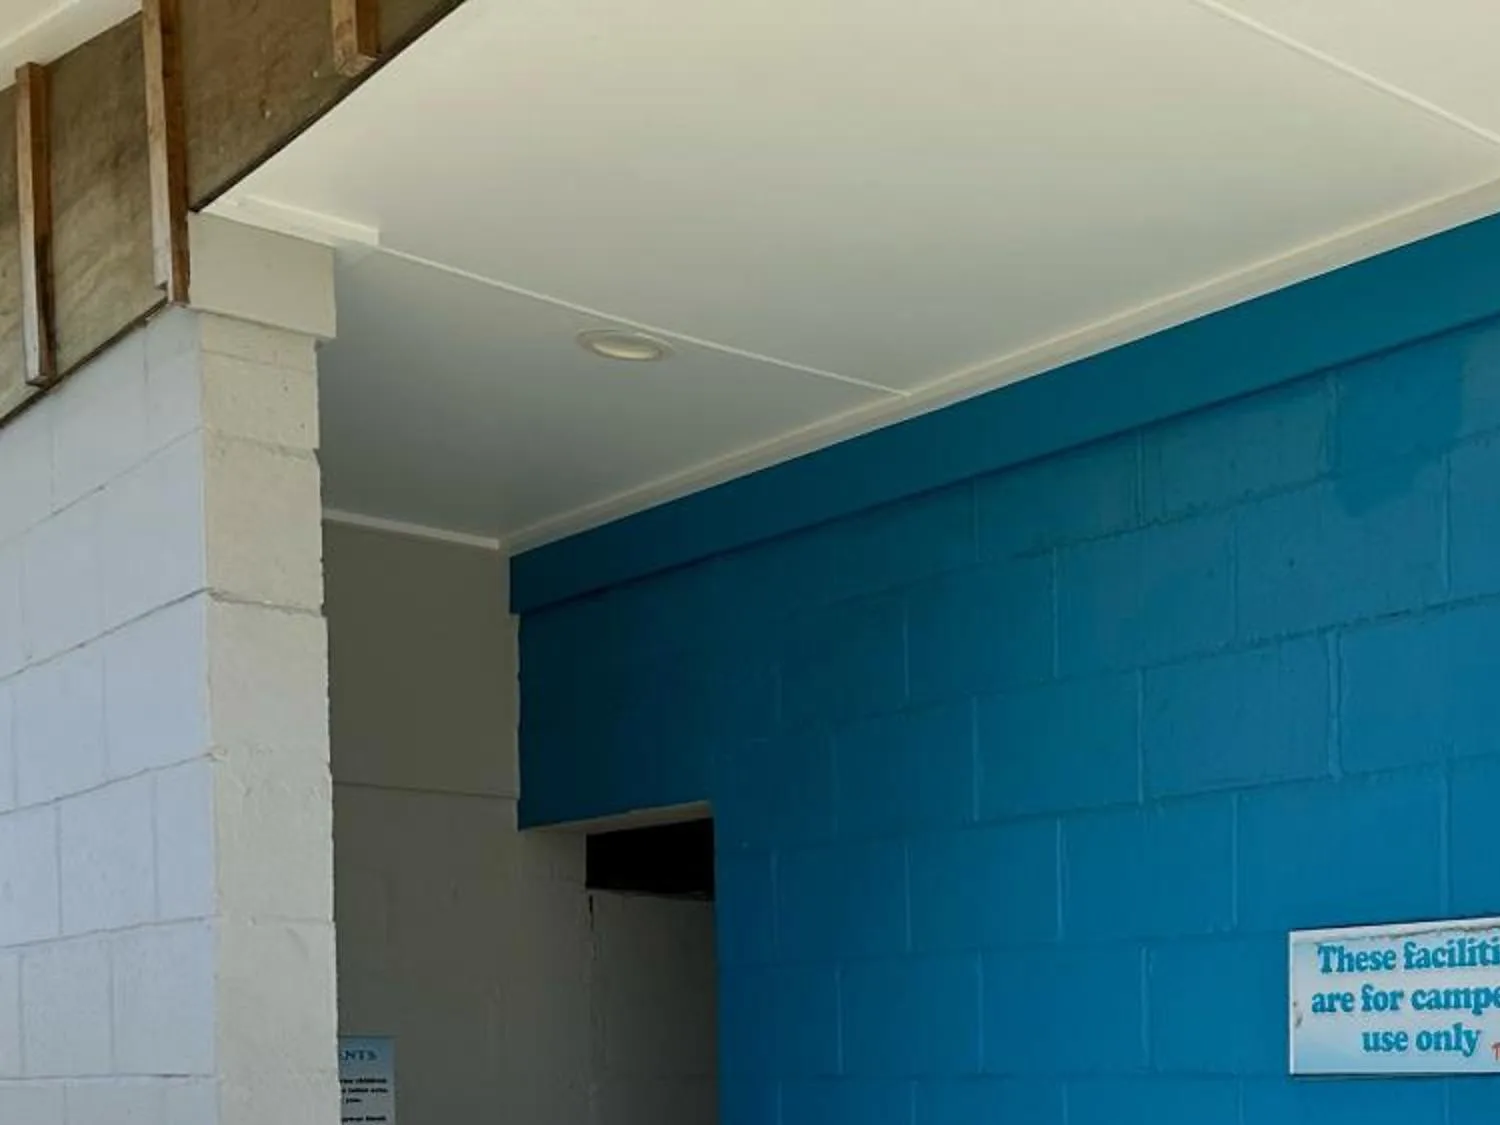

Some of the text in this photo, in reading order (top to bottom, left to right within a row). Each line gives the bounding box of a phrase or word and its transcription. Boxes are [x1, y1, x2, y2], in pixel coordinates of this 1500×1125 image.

[1317, 943, 1396, 973] These
[1311, 991, 1354, 1013] are
[1361, 984, 1404, 1012] for
[1362, 1022, 1482, 1057] use only
